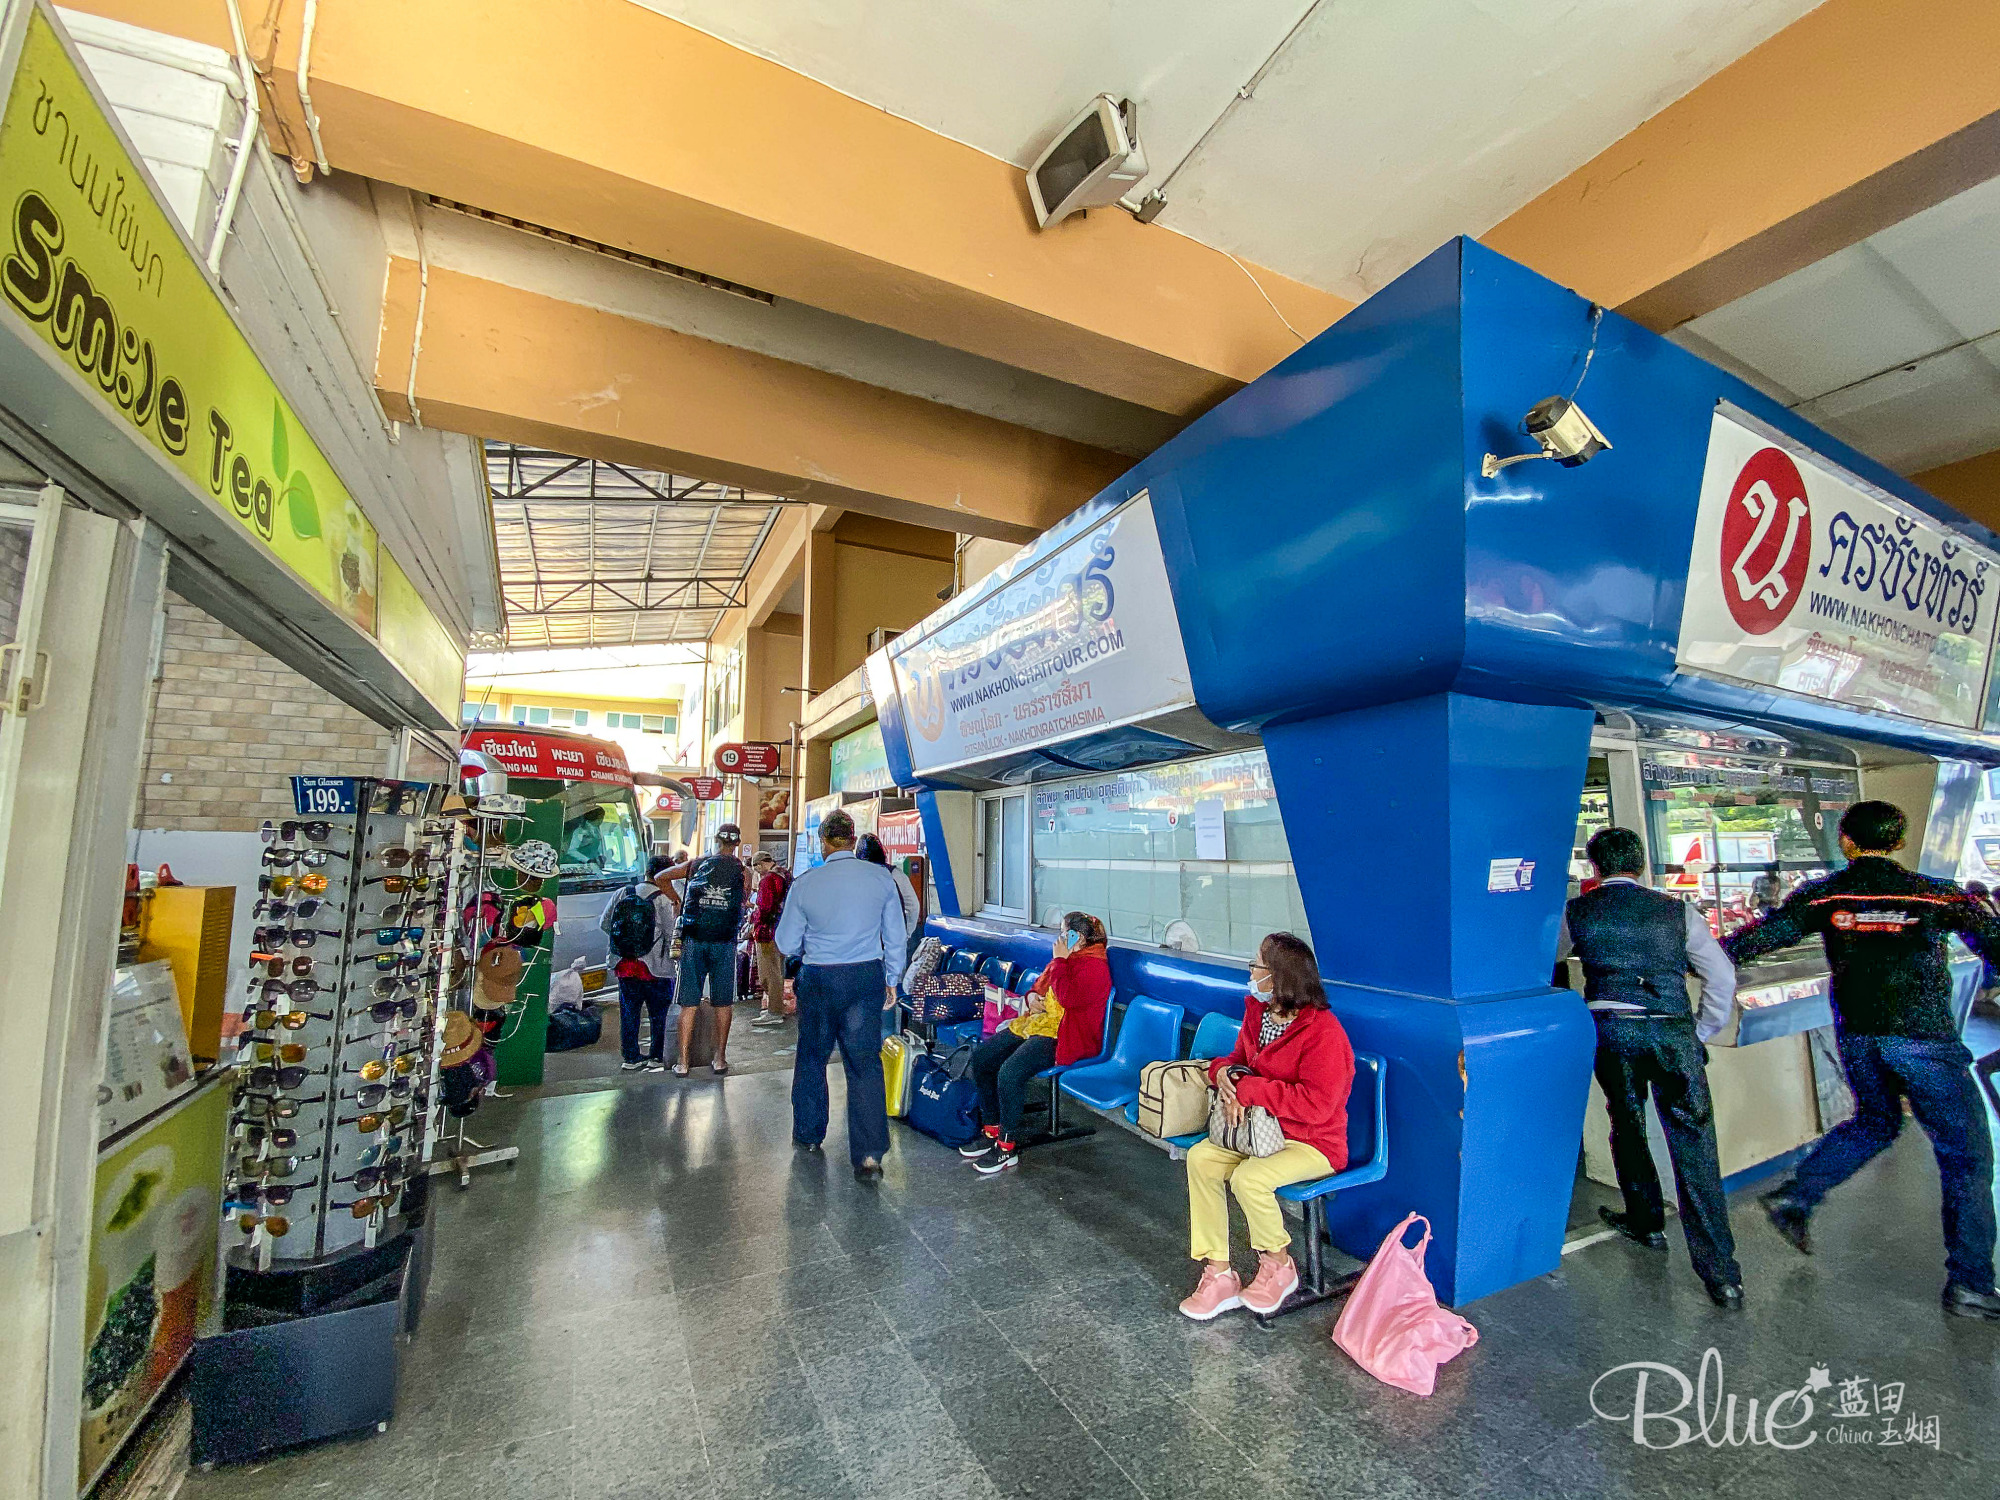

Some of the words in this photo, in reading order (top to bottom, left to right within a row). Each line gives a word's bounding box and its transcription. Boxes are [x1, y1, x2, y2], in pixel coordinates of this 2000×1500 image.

[208, 407, 274, 542] Tea
[480, 738, 538, 759] เชียงใหม่
[551, 748, 585, 764] พะเยา
[724, 752, 736, 763] 19
[522, 763, 538, 774] MAI
[556, 766, 584, 778] PHAYAO
[591, 770, 614, 781] CHIANG
[302, 777, 317, 787] Sun
[317, 777, 344, 787] Glasses
[1168, 813, 1176, 825] 6
